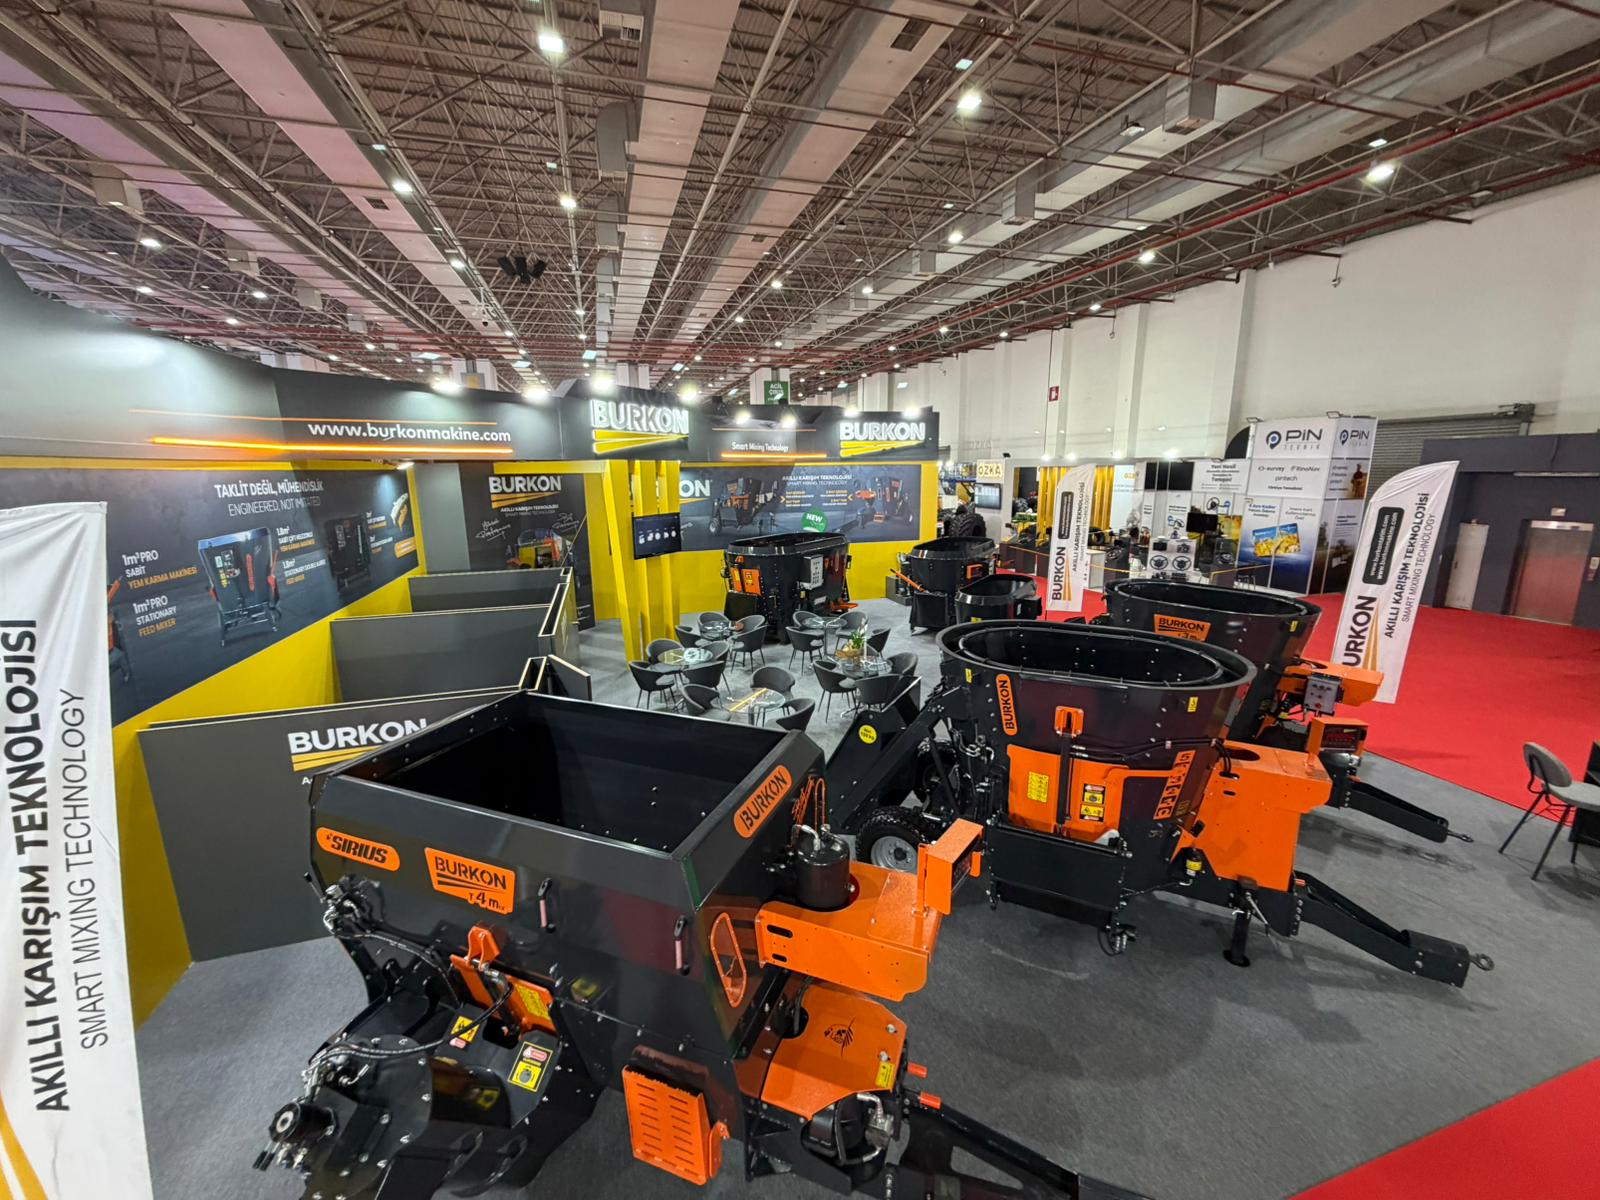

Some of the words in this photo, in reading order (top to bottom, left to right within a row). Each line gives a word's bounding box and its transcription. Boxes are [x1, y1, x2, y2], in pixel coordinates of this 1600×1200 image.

[307, 422, 511, 442] www.burkonmakine.com
[589, 399, 689, 434] BURKON
[840, 421, 926, 440] BURKON
[731, 441, 748, 451] Smart
[213, 480, 248, 498] TAKLİT
[489, 475, 561, 493] BURKON
[806, 513, 823, 523] NEW
[141, 550, 159, 562] PRO
[1415, 513, 1436, 568] TECHNOLOGY
[1052, 546, 1066, 601] BURKON
[1384, 606, 1400, 639] AKILLI
[1392, 562, 1411, 606] KARIŞIM
[1403, 492, 1430, 561] TEKNOLOJİSİ
[1407, 568, 1423, 599] MIXING
[136, 606, 176, 626] STATIONARY
[150, 595, 168, 607] PRO
[1401, 596, 1415, 623] SMART
[1159, 617, 1205, 632] BURKON
[1341, 595, 1377, 667] URKON
[1000, 679, 1015, 730] BURKON
[288, 718, 427, 754] BURKON
[60, 688, 94, 873] TECHNOLOGY
[739, 770, 787, 831] BURKON
[330, 834, 389, 865] SIRIUS
[434, 856, 507, 890] BURKON
[19, 865, 61, 1008] KARIŞIM
[67, 877, 101, 965] MIXING
[74, 972, 109, 1050] SMART
[26, 1015, 70, 1111] AKILLI
